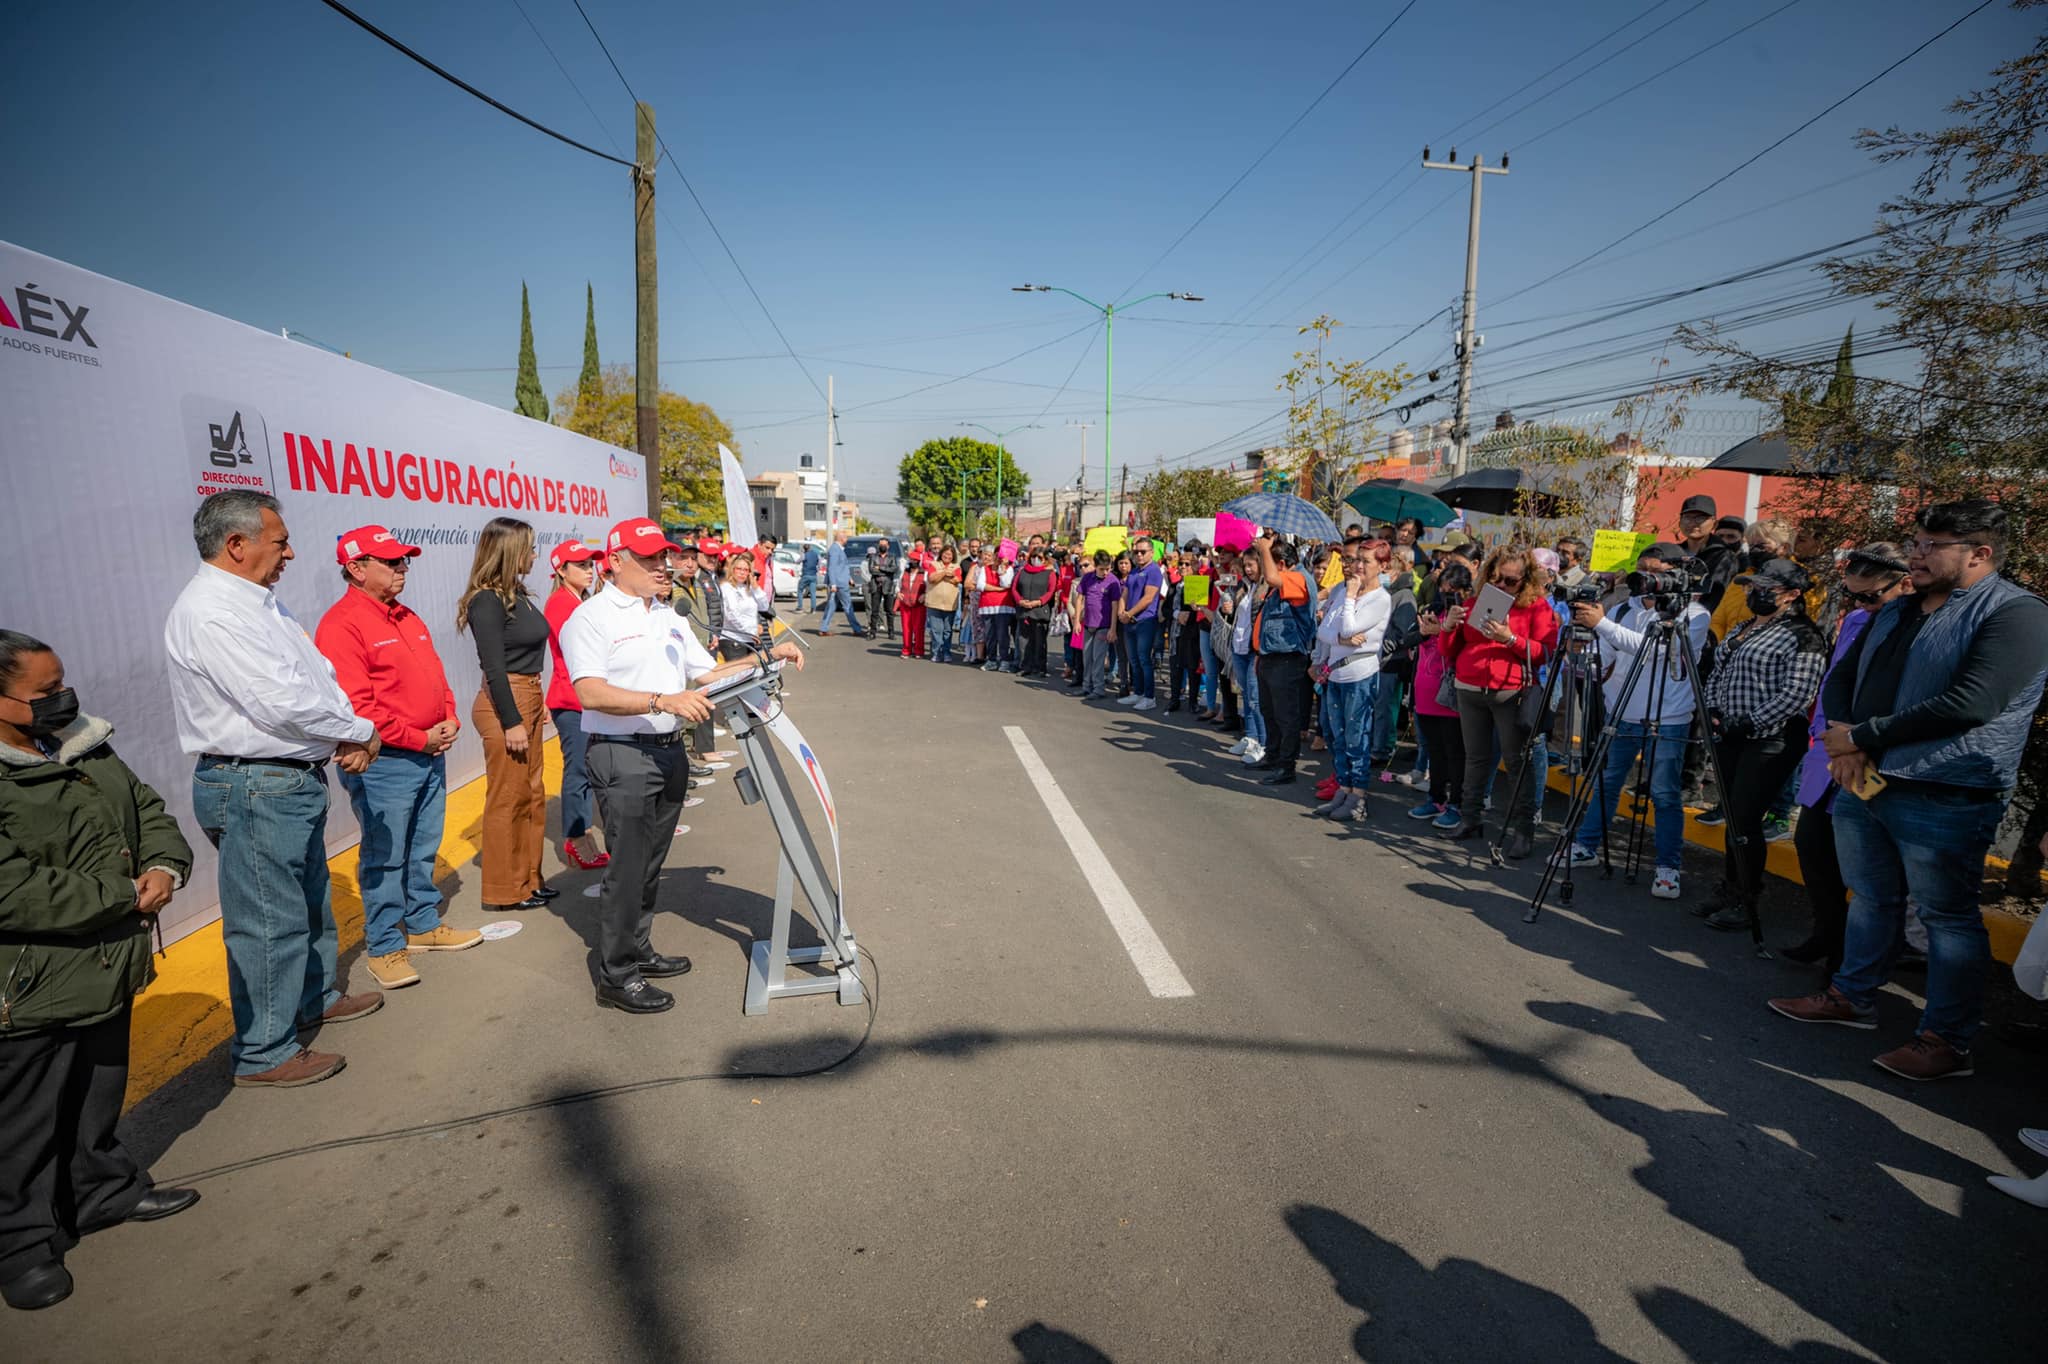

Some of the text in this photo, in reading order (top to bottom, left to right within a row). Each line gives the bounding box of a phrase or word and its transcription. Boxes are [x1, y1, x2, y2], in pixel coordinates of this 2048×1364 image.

[0, 283, 98, 349] ÉX
[0, 336, 40, 354] ADOS
[252, 477, 264, 486] DE
[283, 432, 609, 517] INAUGURACIÓN DE OBRA
[390, 523, 469, 546] experiencia
[537, 531, 553, 560] que
